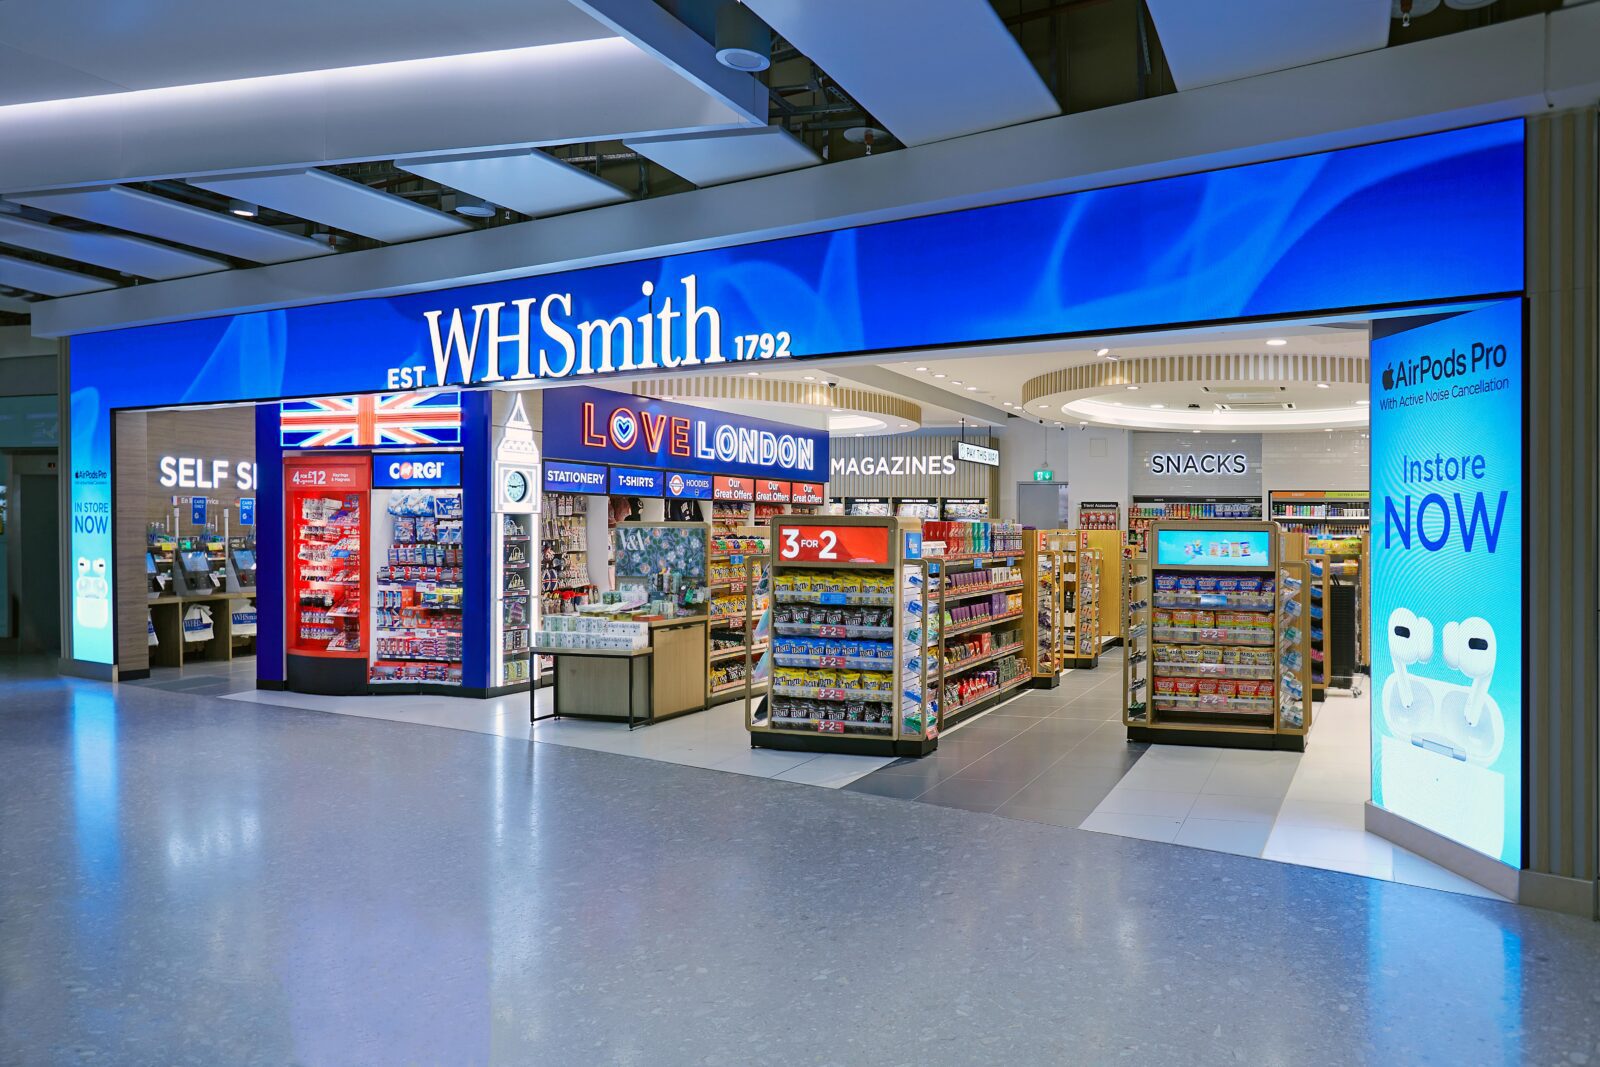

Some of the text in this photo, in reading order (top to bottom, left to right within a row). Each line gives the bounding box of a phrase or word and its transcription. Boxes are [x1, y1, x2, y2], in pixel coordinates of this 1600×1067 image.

[387, 274, 792, 389] EST WHSmith 1792
[1395, 342, 1507, 389] AirPods Pro
[1380, 377, 1509, 411] With Active Noise Cancellation
[582, 402, 814, 471] LOVE LONDON
[389, 461, 444, 480] CORGI
[830, 455, 956, 476] MAGAZINES
[1151, 454, 1246, 475] SNACKS
[1403, 453, 1486, 484] Instore
[79, 470, 107, 479] AirPods Pro
[160, 456, 229, 489] SELF
[292, 470, 300, 485] 4
[307, 470, 326, 485] £12
[547, 470, 605, 485] STATIONERY
[618, 475, 654, 488] T-SHIRTS
[686, 479, 709, 488] HOODIES
[728, 479, 740, 488] Our
[768, 481, 778, 491] Our
[803, 483, 813, 493] Our
[715, 489, 753, 500] Great Offers
[756, 491, 790, 502] Great Offers
[792, 493, 823, 504] Great Offers
[74, 502, 109, 513] IN STORE
[74, 515, 109, 534] NOW
[1384, 490, 1508, 554] NOW
[618, 529, 646, 551] V&A
[781, 528, 838, 560] 3 FOR 2
[821, 626, 827, 635] 3
[830, 627, 837, 636] 2
[820, 657, 826, 666] 3
[830, 658, 836, 666] 2
[819, 689, 826, 698] 3
[829, 690, 835, 698] 2
[819, 721, 826, 730] 3
[829, 722, 835, 731] 2
